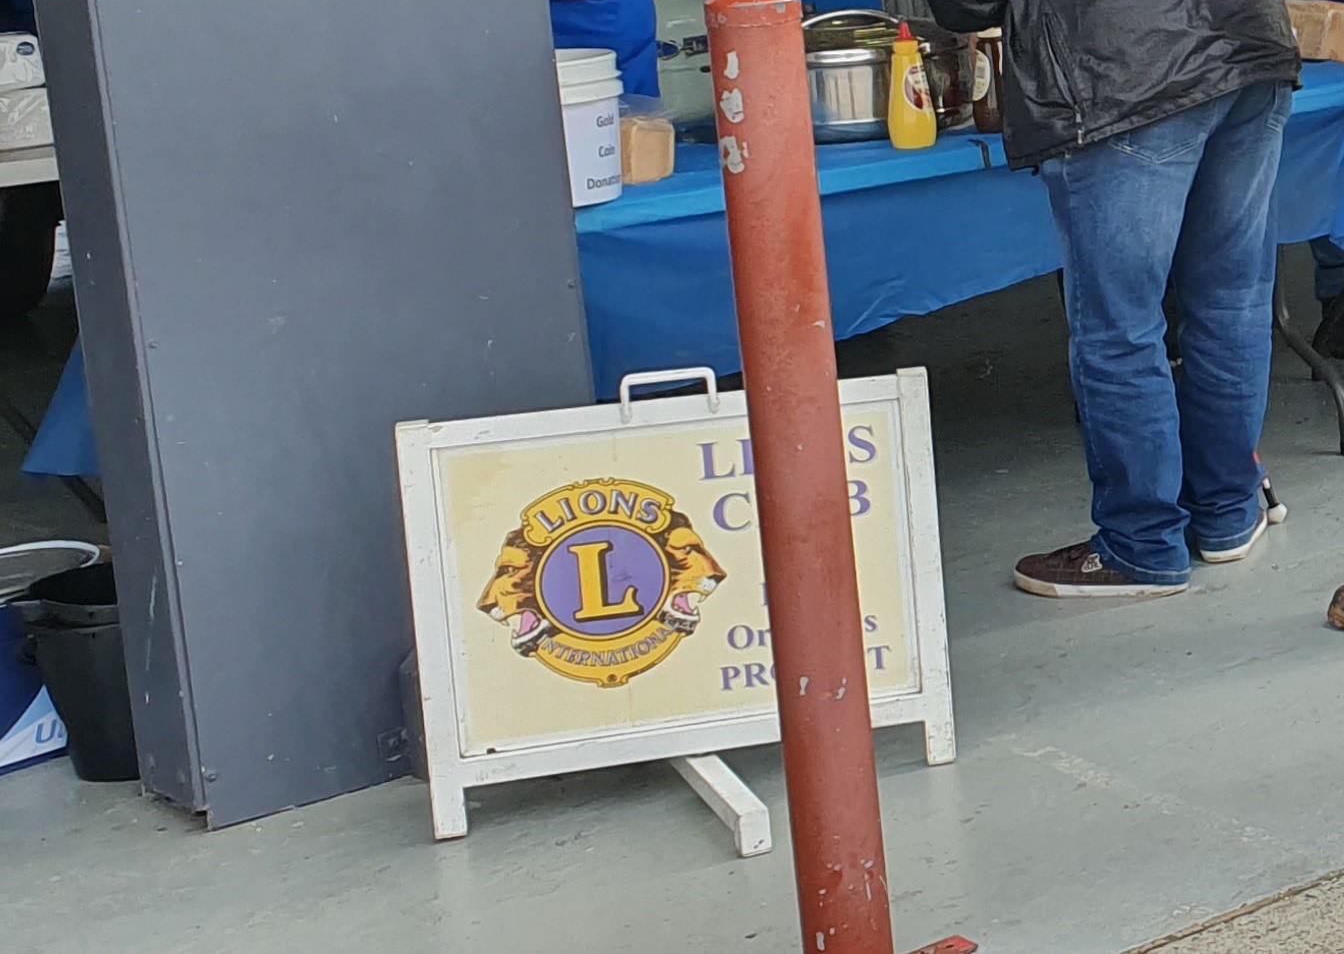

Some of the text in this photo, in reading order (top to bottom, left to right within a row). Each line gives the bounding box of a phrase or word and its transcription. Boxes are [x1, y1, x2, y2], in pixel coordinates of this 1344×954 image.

[596, 113, 614, 128] Gold
[598, 144, 616, 158] Coin
[698, 425, 877, 481] LIS
[535, 489, 662, 534] LIONS
